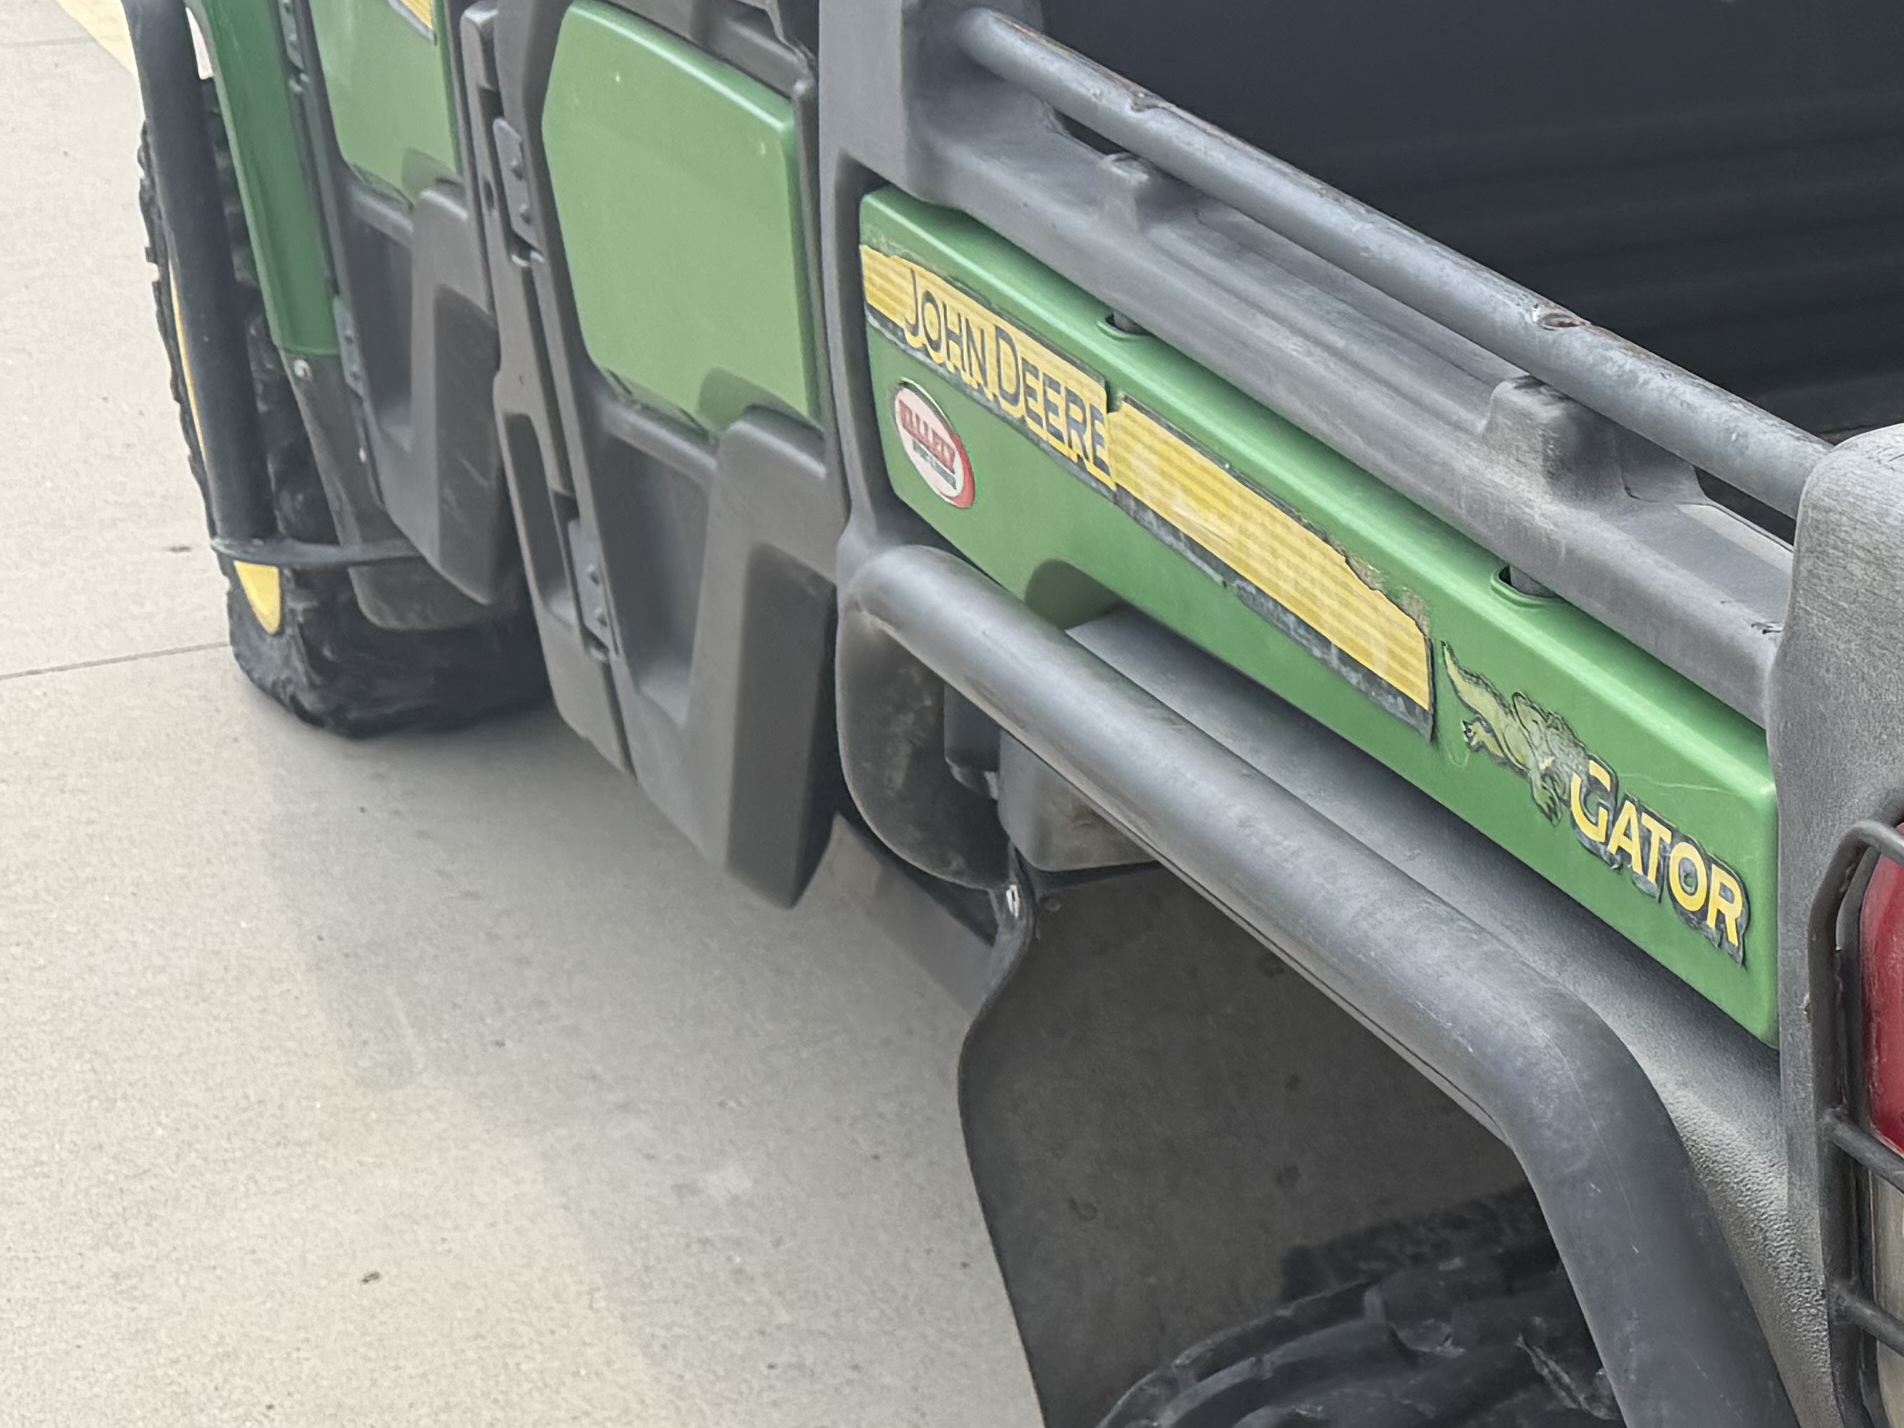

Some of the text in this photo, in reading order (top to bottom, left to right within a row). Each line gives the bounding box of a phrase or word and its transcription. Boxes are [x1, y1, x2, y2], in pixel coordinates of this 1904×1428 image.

[904, 267, 988, 392] JOHN
[995, 324, 1112, 478] DEERE
[1570, 759, 1744, 948] GATOR
